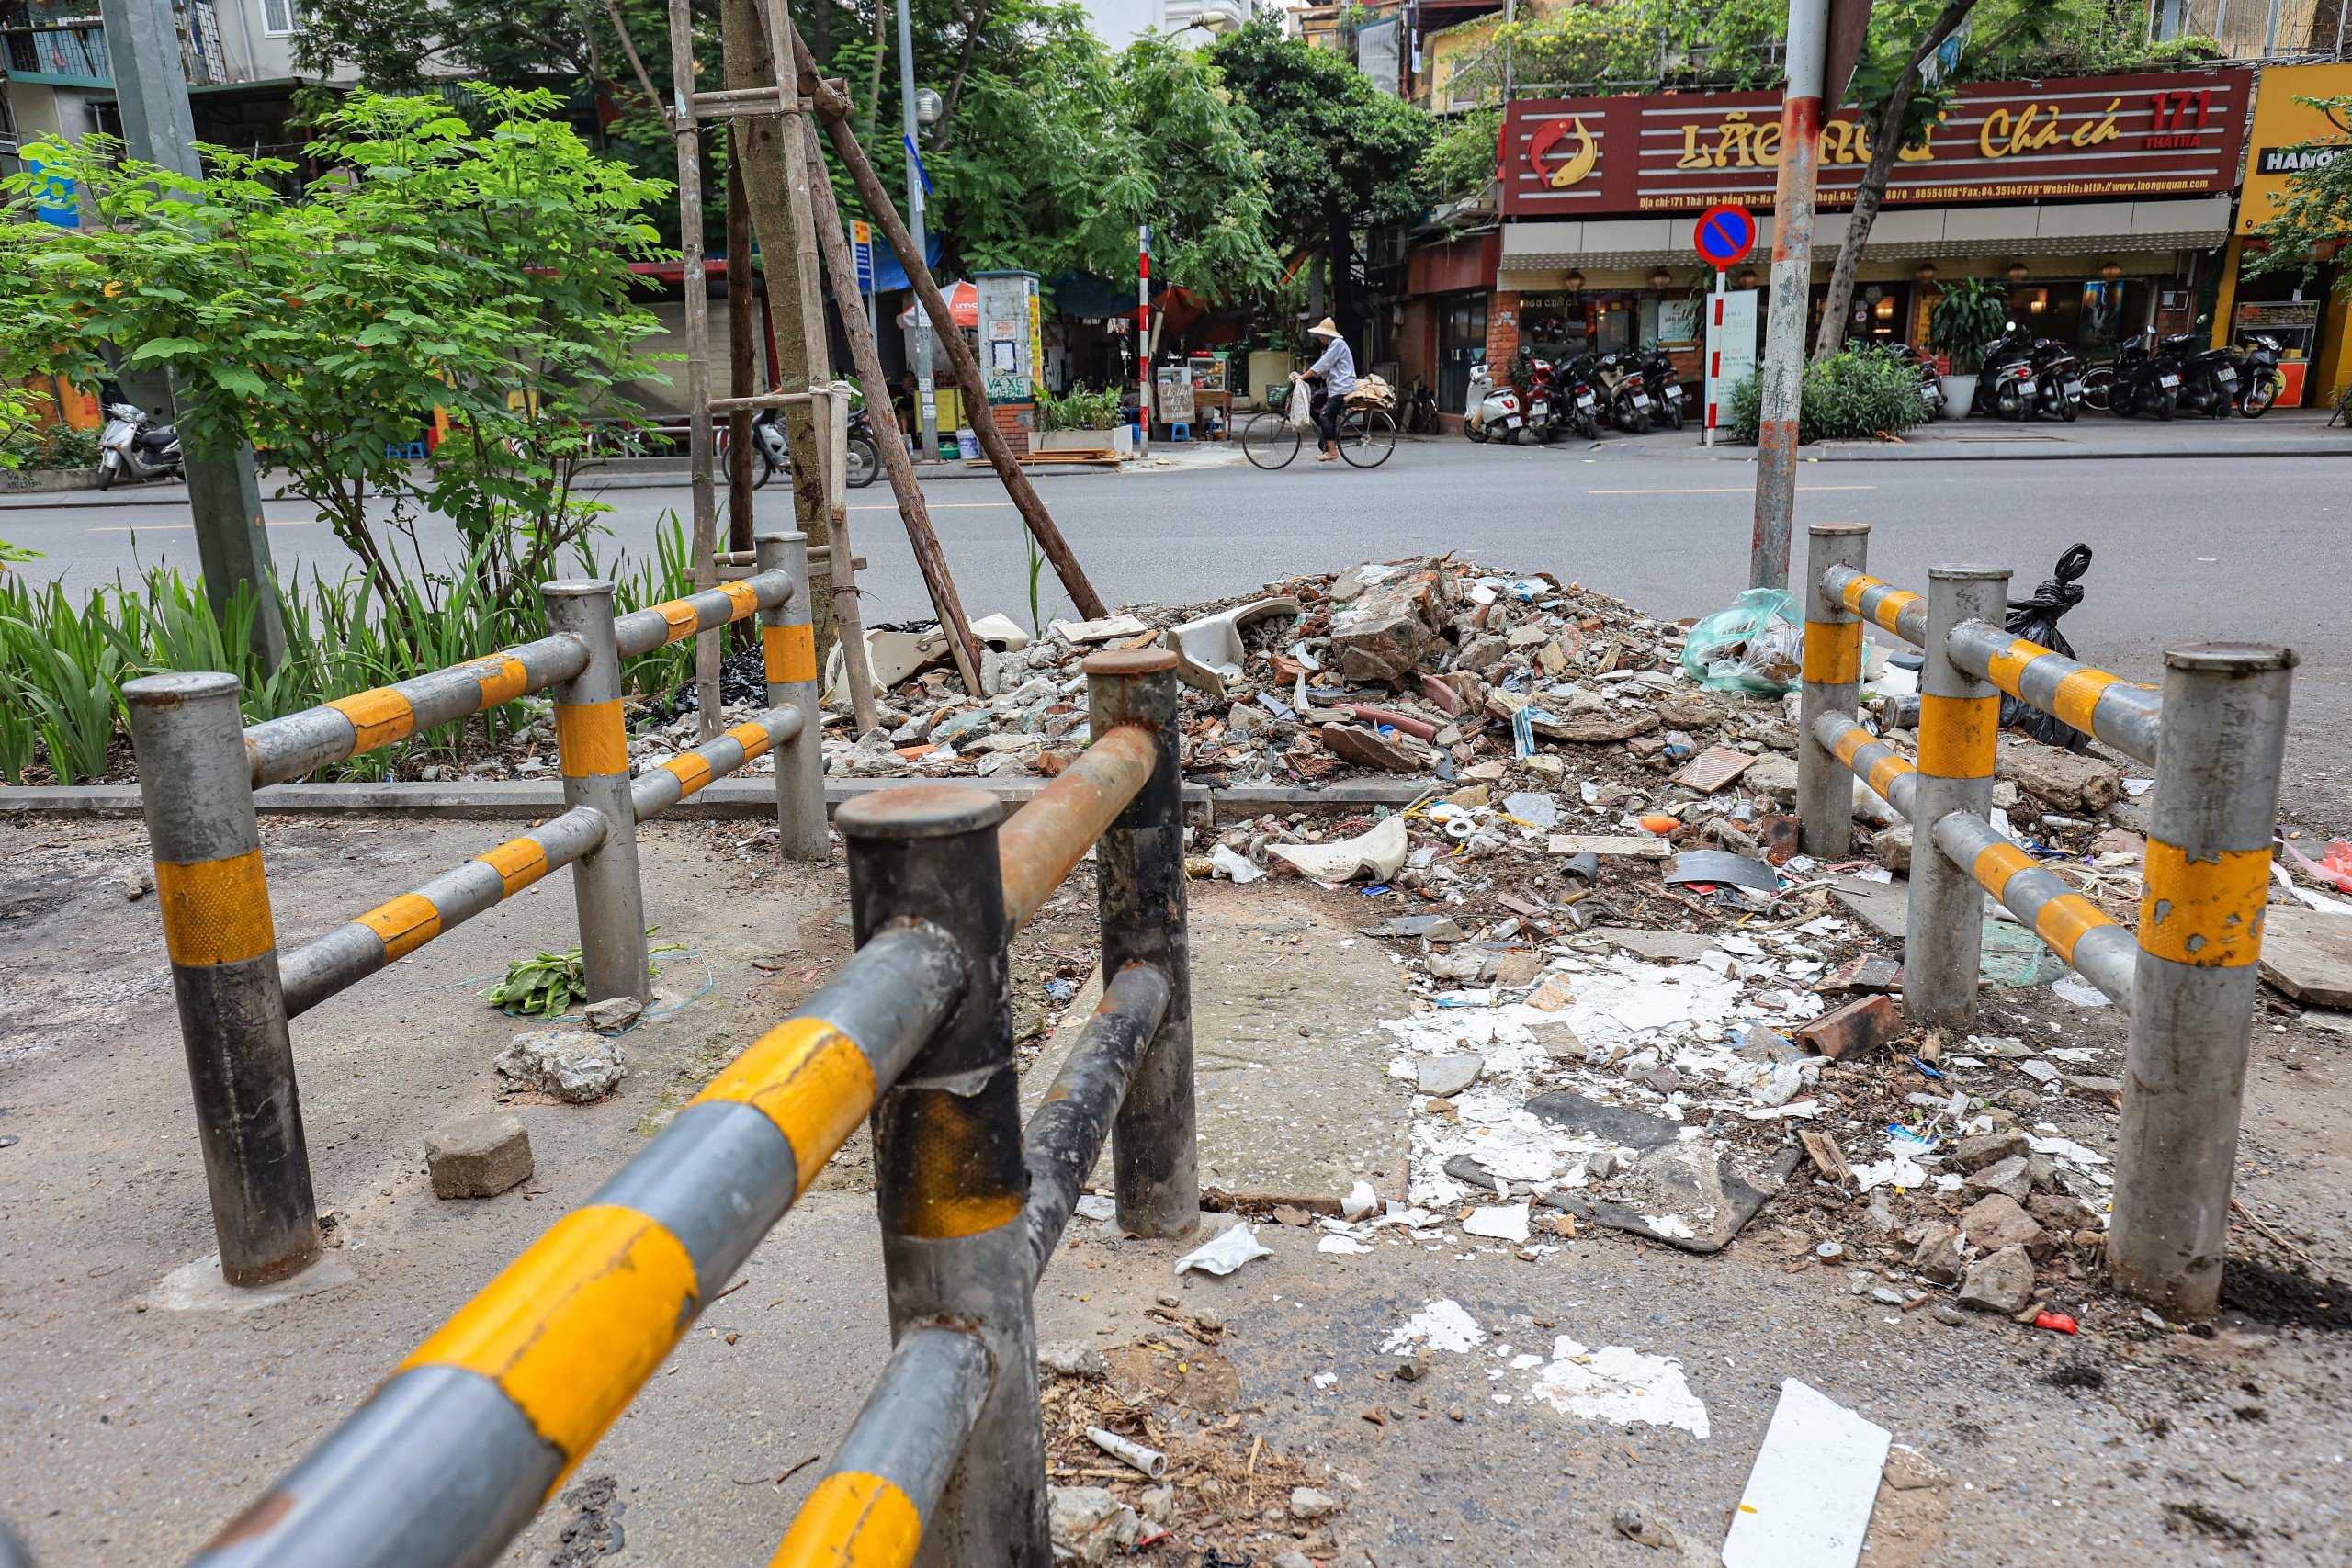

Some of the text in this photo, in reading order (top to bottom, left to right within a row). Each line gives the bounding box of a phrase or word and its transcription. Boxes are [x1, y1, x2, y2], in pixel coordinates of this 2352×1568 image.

[1980, 104, 2062, 159] Chả
[2071, 97, 2121, 147] cá
[2151, 89, 2211, 130] 171
[1686, 195, 1704, 207] Thái
